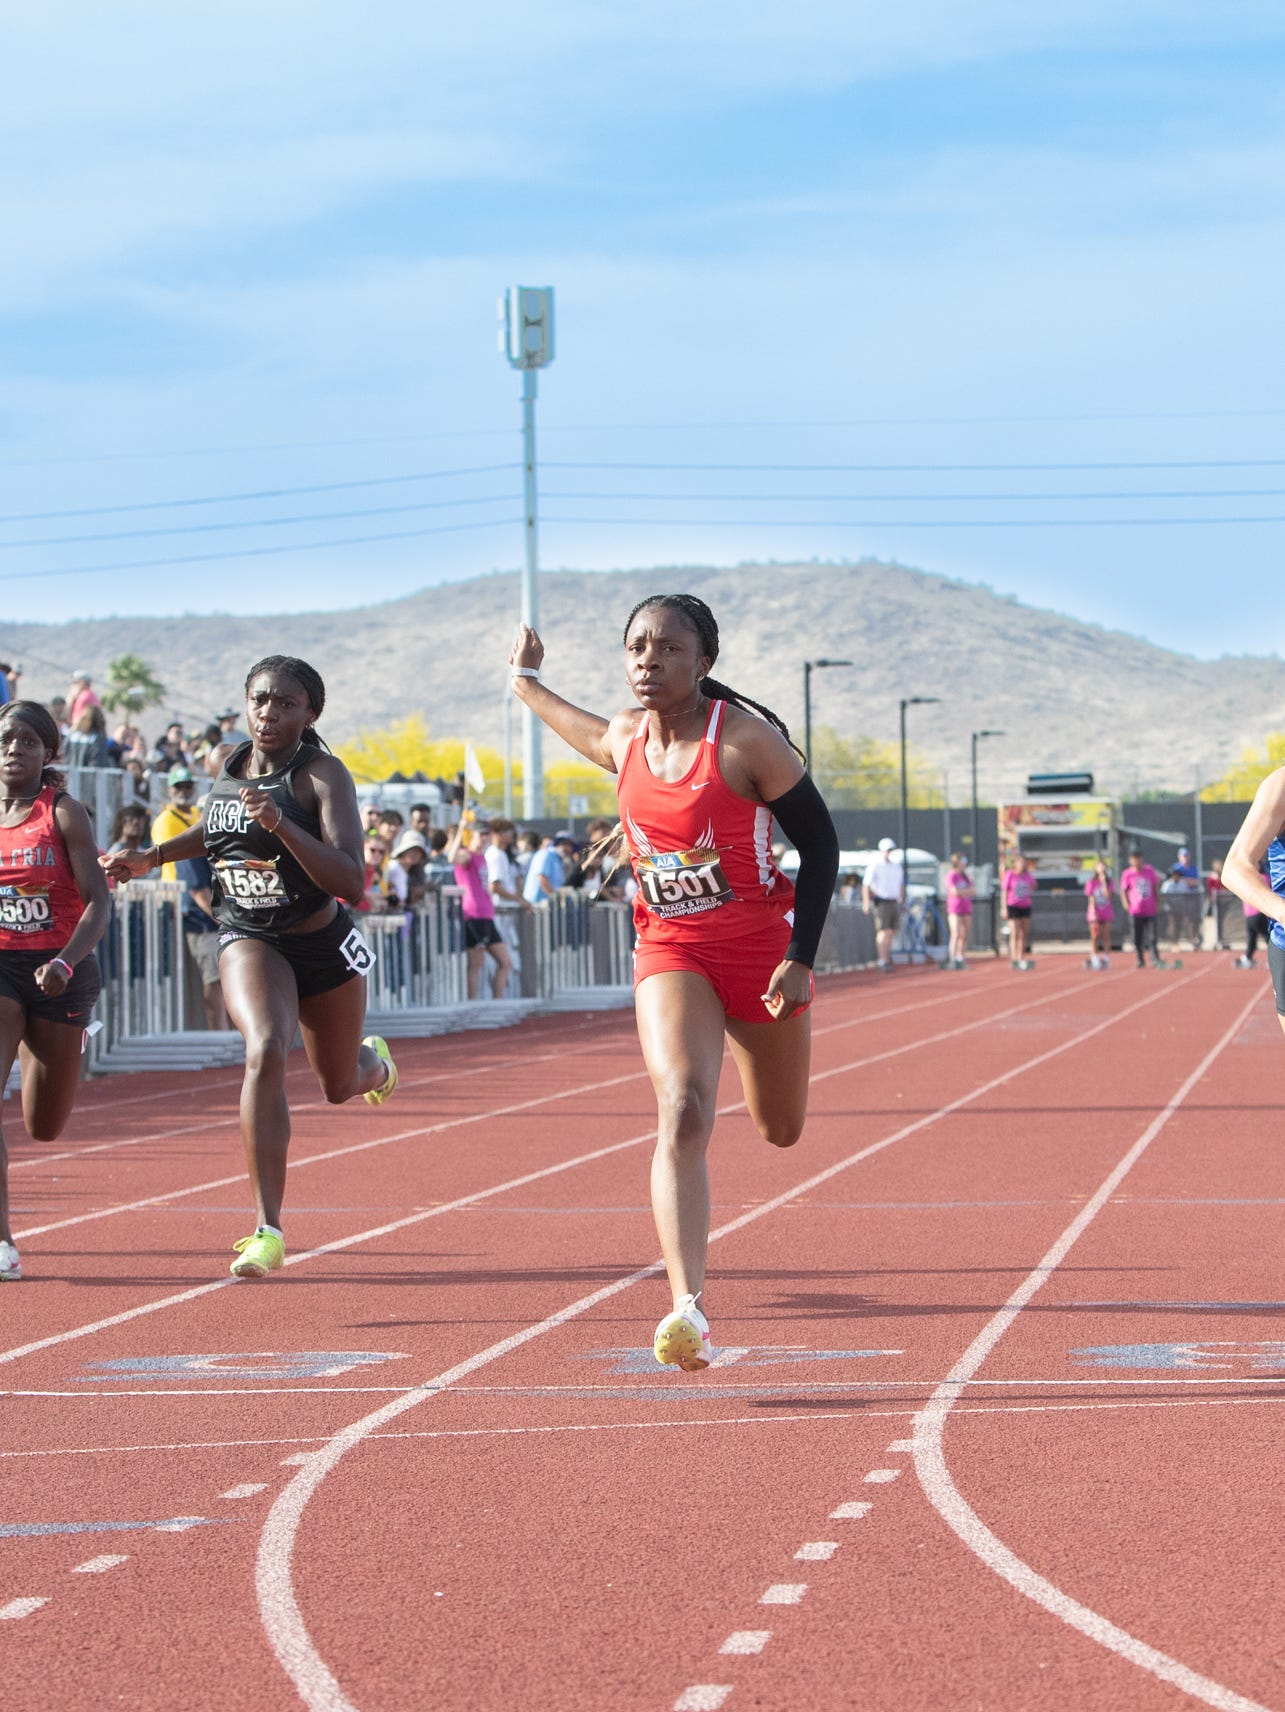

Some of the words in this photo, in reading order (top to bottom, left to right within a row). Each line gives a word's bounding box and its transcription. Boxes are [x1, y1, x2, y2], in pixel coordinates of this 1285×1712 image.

[11, 847, 56, 867] FRIA
[656, 856, 676, 868] AIA
[219, 868, 284, 897] 1582
[641, 865, 721, 903] 1501
[0, 897, 49, 923] 500
[659, 900, 723, 919] CHAMPIONSHIPS
[660, 902, 687, 912] TRACK
[695, 897, 717, 906] FIELD
[344, 934, 371, 969] 5
